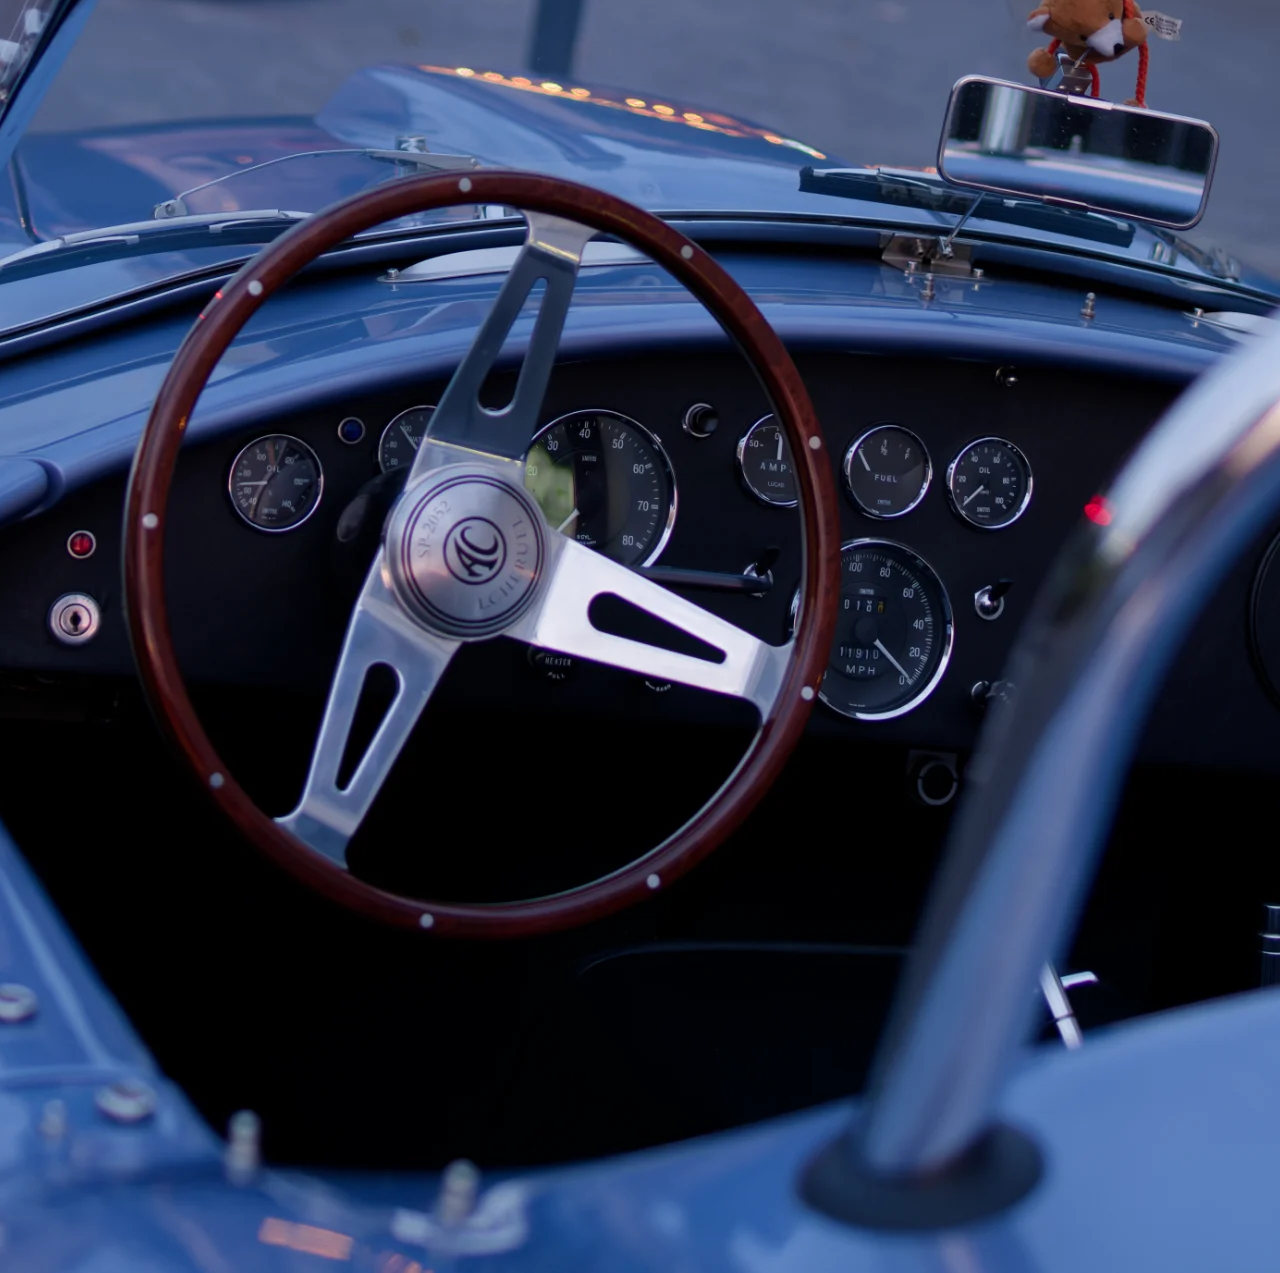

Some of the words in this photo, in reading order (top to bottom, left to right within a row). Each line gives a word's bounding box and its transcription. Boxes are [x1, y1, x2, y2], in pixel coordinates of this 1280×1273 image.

[579, 429, 591, 439] 40
[547, 441, 559, 451] 30
[612, 440, 624, 449] 50
[267, 465, 280, 473] OIL
[527, 466, 538, 476] 20
[633, 464, 644, 474] 60
[760, 462, 793, 473] AMP
[874, 474, 898, 483] FUEL
[248, 497, 257, 505] 40
[637, 501, 649, 511] 70
[419, 500, 452, 558] SP-2052
[622, 535, 634, 545] 80
[454, 526, 499, 577] AC
[849, 562, 862, 573] 100
[880, 567, 891, 578] 80
[903, 588, 914, 599] 60
[913, 619, 924, 630] 40
[909, 647, 920, 657] 20
[846, 664, 876, 675] MPH
